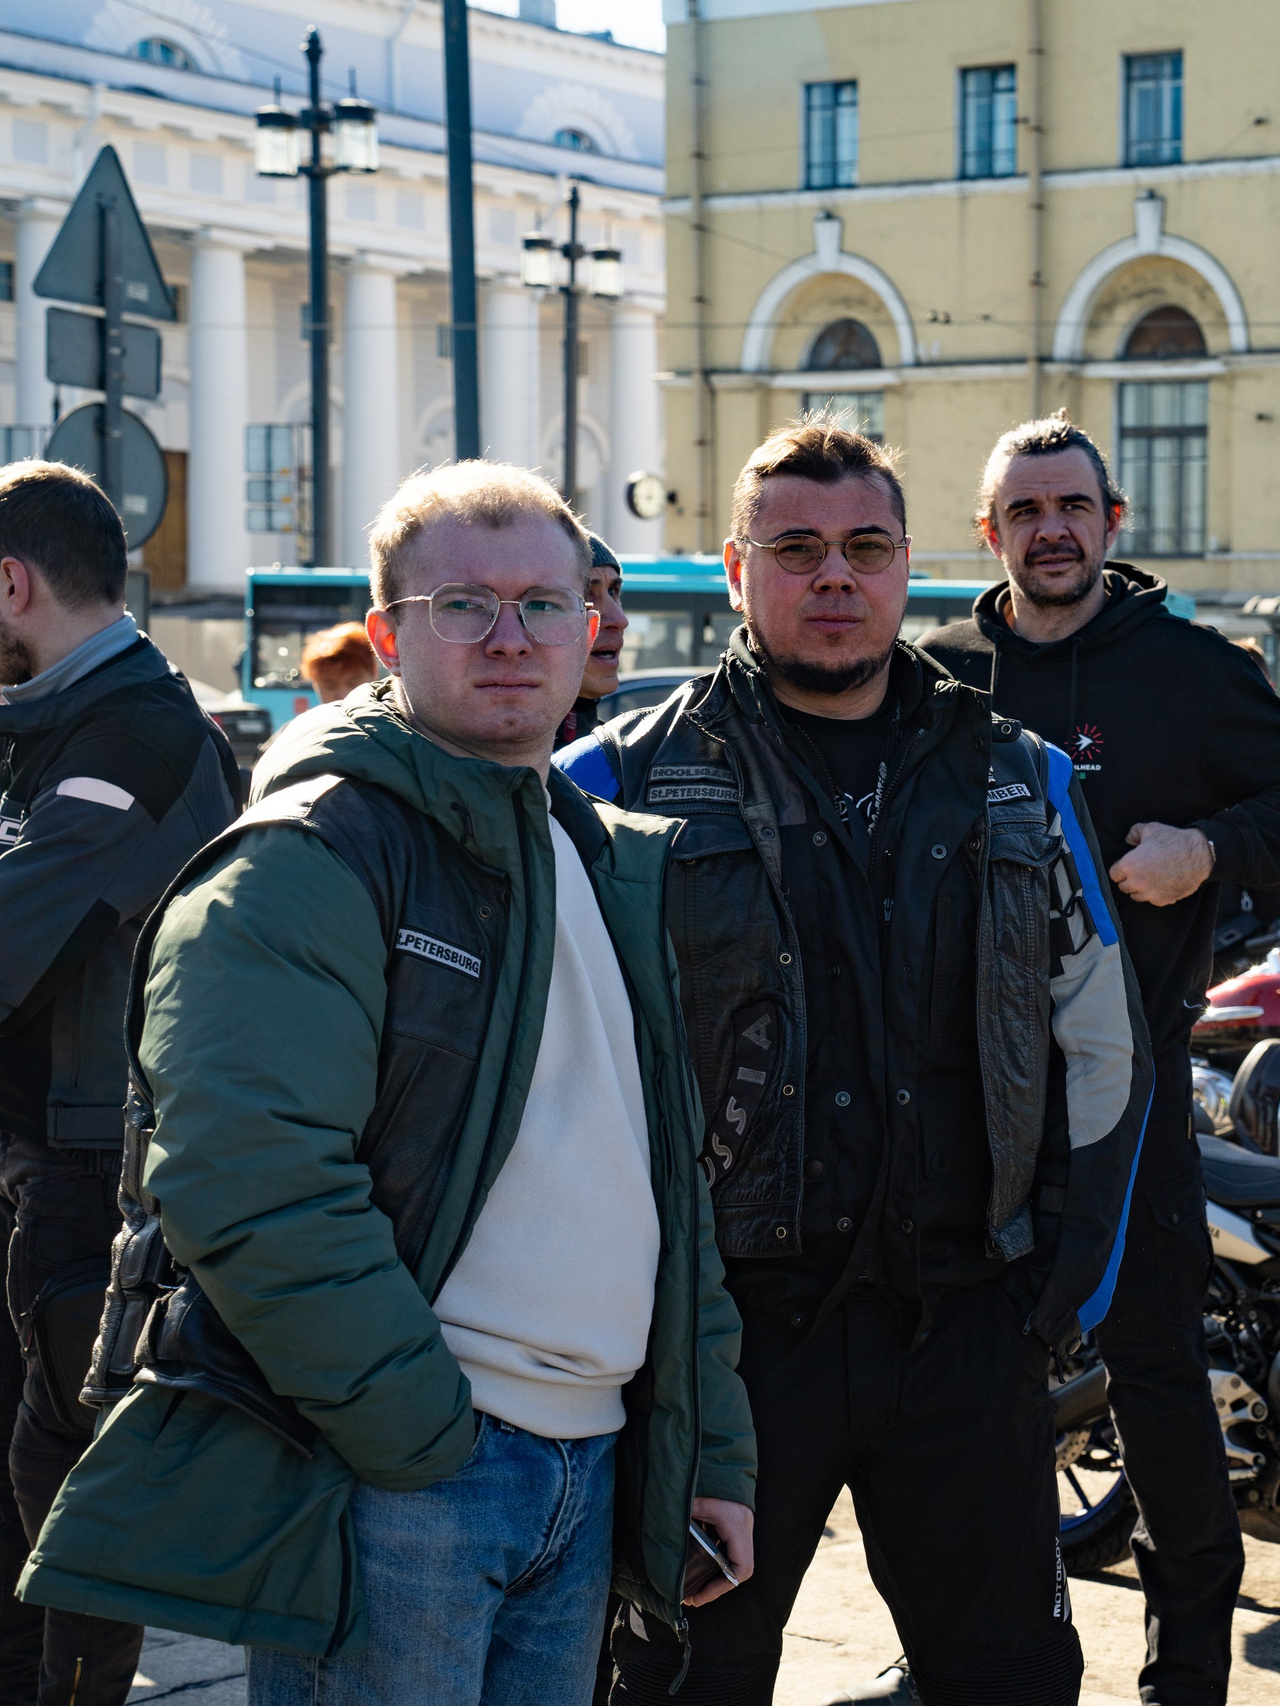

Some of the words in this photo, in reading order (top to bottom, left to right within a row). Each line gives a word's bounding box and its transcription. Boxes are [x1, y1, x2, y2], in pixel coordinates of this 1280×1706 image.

[652, 768, 736, 779] HOOLIGAN
[988, 785, 1027, 800] MBER
[397, 932, 479, 974] t.PETERSBURG
[705, 1013, 773, 1189] USSIA
